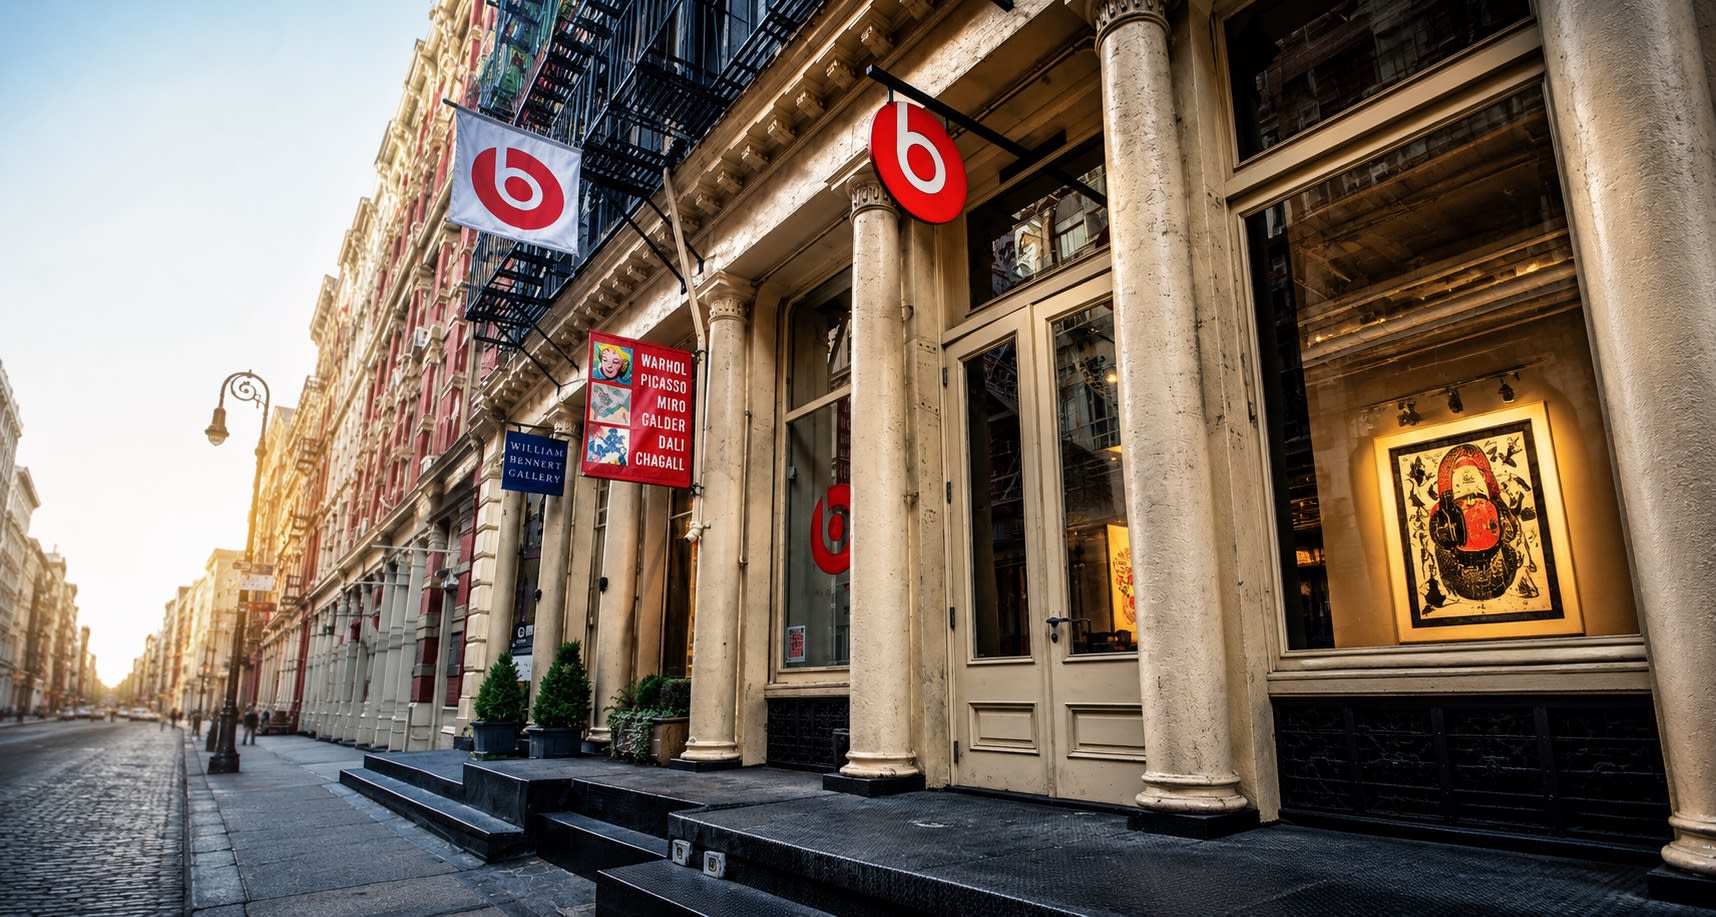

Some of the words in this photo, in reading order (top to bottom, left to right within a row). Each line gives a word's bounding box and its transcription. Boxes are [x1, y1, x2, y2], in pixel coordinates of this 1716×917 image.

[896, 101, 947, 194] b
[641, 353, 687, 376] WARHOL
[641, 373, 687, 394] PICASSO
[657, 395, 686, 413] MIRO
[641, 412, 686, 432] CALDER
[510, 441, 564, 458] WILLIAM
[658, 435, 685, 452] DALI
[635, 451, 685, 471] CHAGALL
[508, 468, 561, 484] GALLERY
